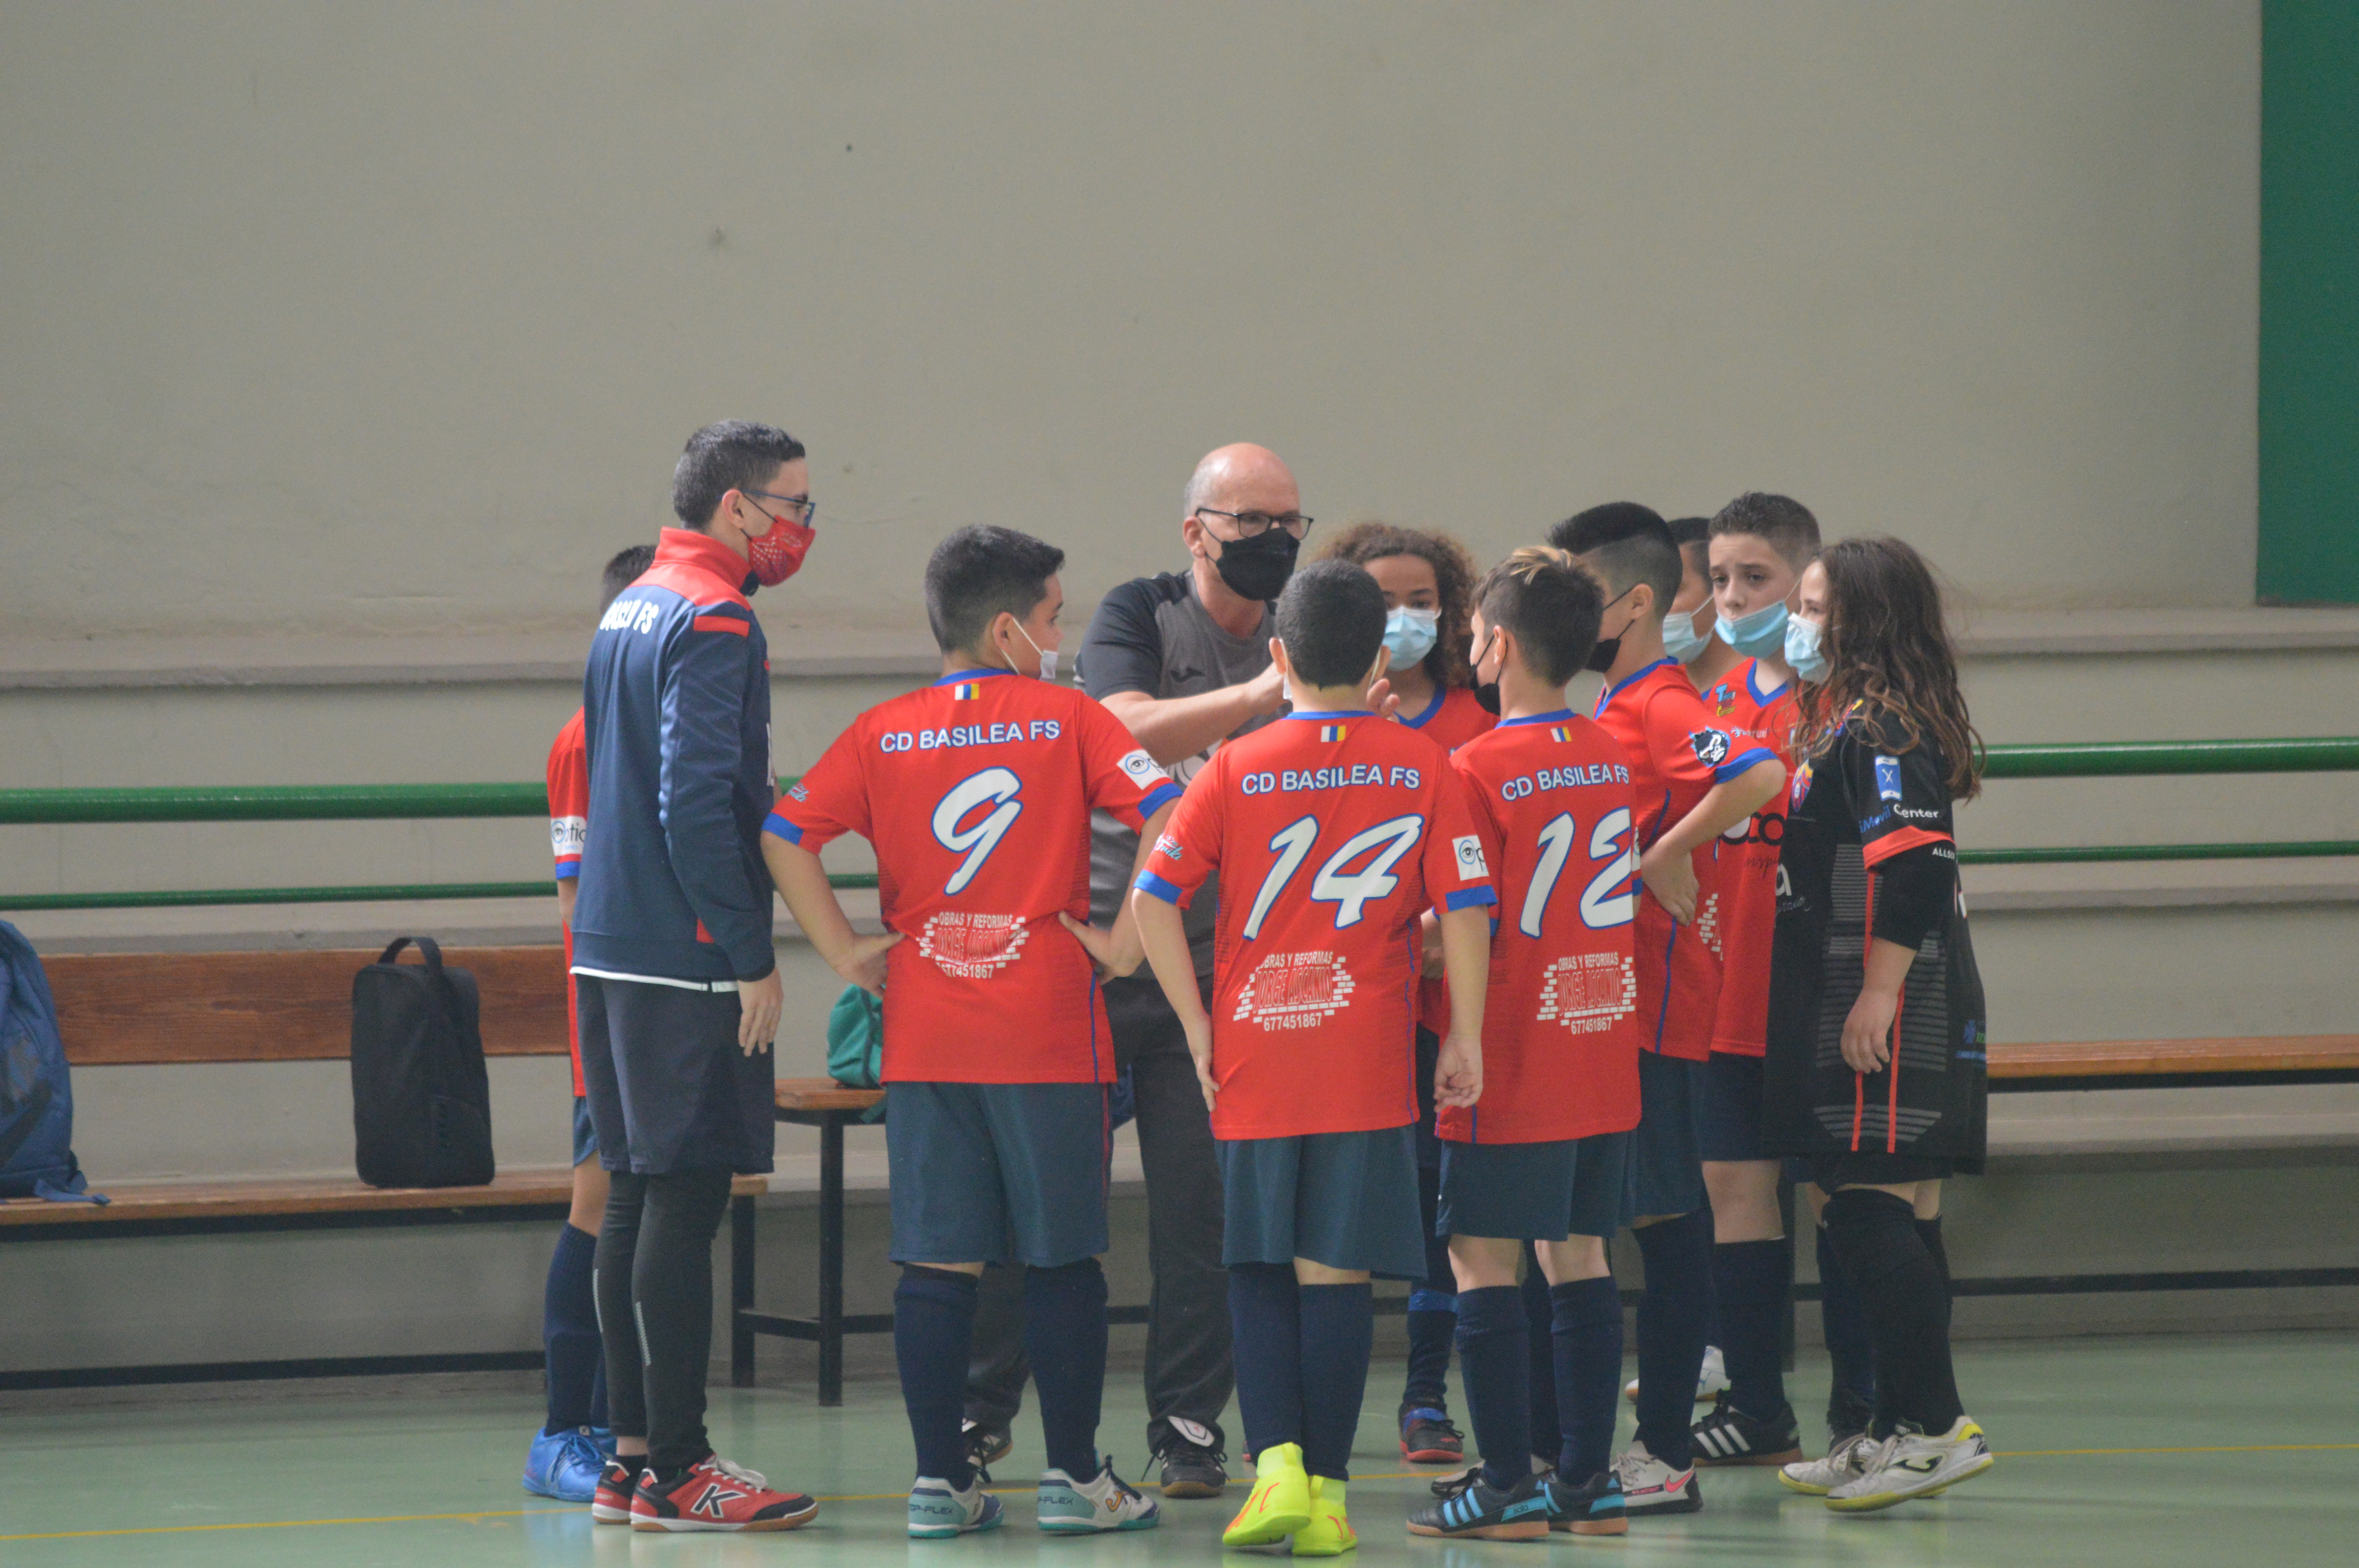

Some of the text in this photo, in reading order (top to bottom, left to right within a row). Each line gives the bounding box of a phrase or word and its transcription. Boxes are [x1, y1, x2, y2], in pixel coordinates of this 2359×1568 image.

[633, 601, 659, 635] FS
[880, 719, 1061, 753] CD BASILEA FS
[1241, 764, 1421, 796] CD BASILEA FS
[1501, 762, 1630, 802] CD BASILEA FS
[1894, 804, 1939, 818] Center
[931, 766, 1023, 896] 9
[1243, 813, 1425, 941] 14
[1519, 805, 1634, 940] 12
[939, 911, 1013, 928] OBRAS Y REFORMAS
[1287, 953, 1293, 967] Y
[1294, 951, 1333, 966] REFORMAS
[1558, 951, 1619, 971] OBRAS Y REFORMAS
[1253, 969, 1289, 1014] JORGE
[1263, 1012, 1322, 1032] 677451867
[1571, 1016, 1612, 1039] 677451867
